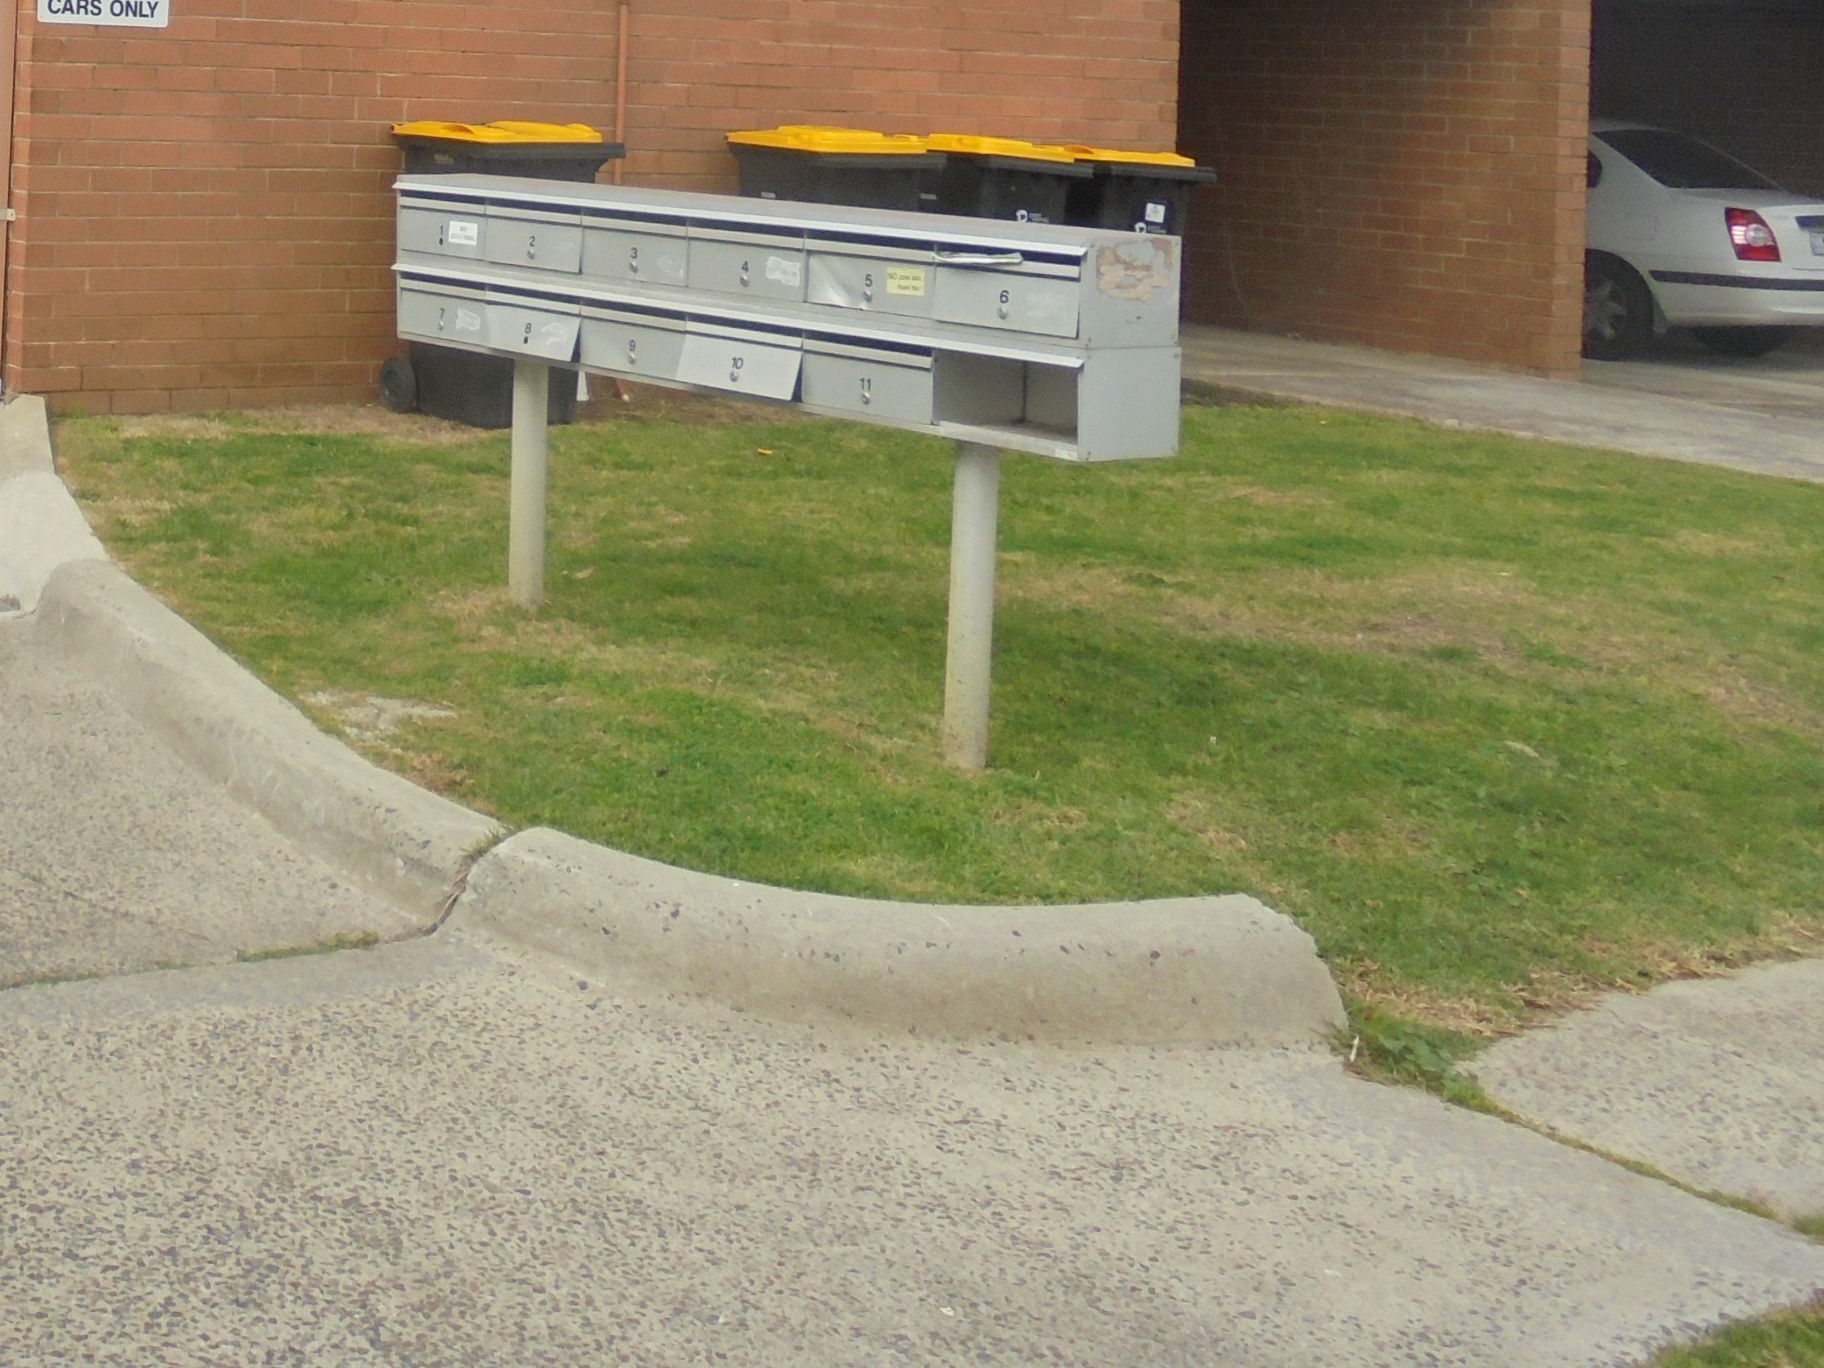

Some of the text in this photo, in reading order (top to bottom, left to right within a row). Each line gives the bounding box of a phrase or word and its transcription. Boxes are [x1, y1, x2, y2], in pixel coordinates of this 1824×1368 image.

[109, 0, 159, 18] ONLY
[439, 225, 444, 235] 1
[529, 236, 535, 247] 2
[630, 247, 638, 259] 3
[741, 261, 749, 272] 4
[864, 274, 873, 287] 5
[999, 290, 1010, 304] 6
[440, 308, 445, 318] 7
[525, 322, 532, 334] 8
[628, 340, 636, 352] 9
[731, 357, 744, 369] 10
[859, 377, 871, 391] 11
